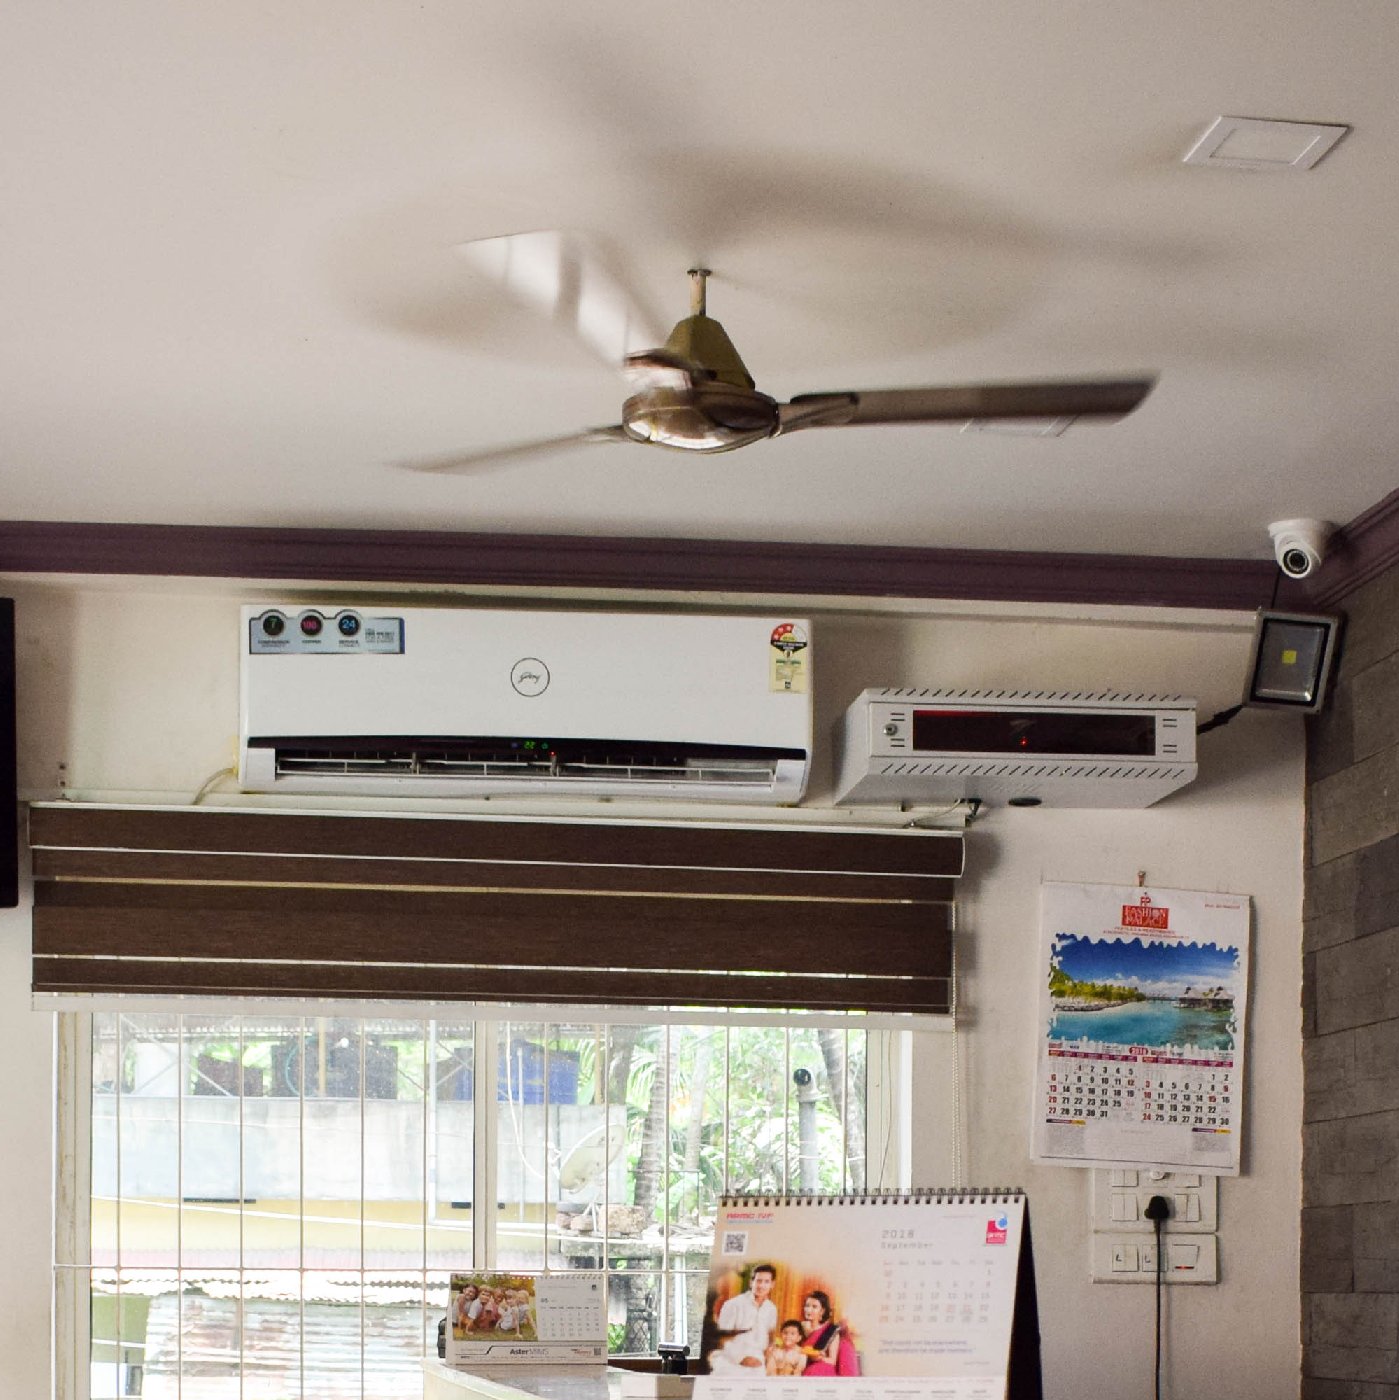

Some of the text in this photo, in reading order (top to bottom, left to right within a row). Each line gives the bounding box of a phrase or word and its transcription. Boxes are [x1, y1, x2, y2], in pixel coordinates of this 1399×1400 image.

[342, 620, 355, 629] 24
[1101, 1077, 1109, 1085] 10
[1101, 1088, 1108, 1096] 17
[1144, 1091, 1151, 1099] 10
[1062, 1096, 1070, 1104] 21
[1074, 1097, 1083, 1105] 22
[1087, 1098, 1096, 1106] 23
[1144, 1102, 1151, 1110] 17
[1181, 1104, 1191, 1112] 20
[1195, 1105, 1203, 1113] 21
[1073, 1108, 1083, 1116] 29
[1086, 1109, 1095, 1117] 30
[1100, 1110, 1108, 1118] 31
[1155, 1113, 1164, 1121] 25
[1194, 1116, 1203, 1124] 28
[1207, 1117, 1216, 1125] 29
[1220, 1117, 1229, 1125] 30
[882, 1230, 915, 1238] 2018
[881, 1242, 934, 1250] September
